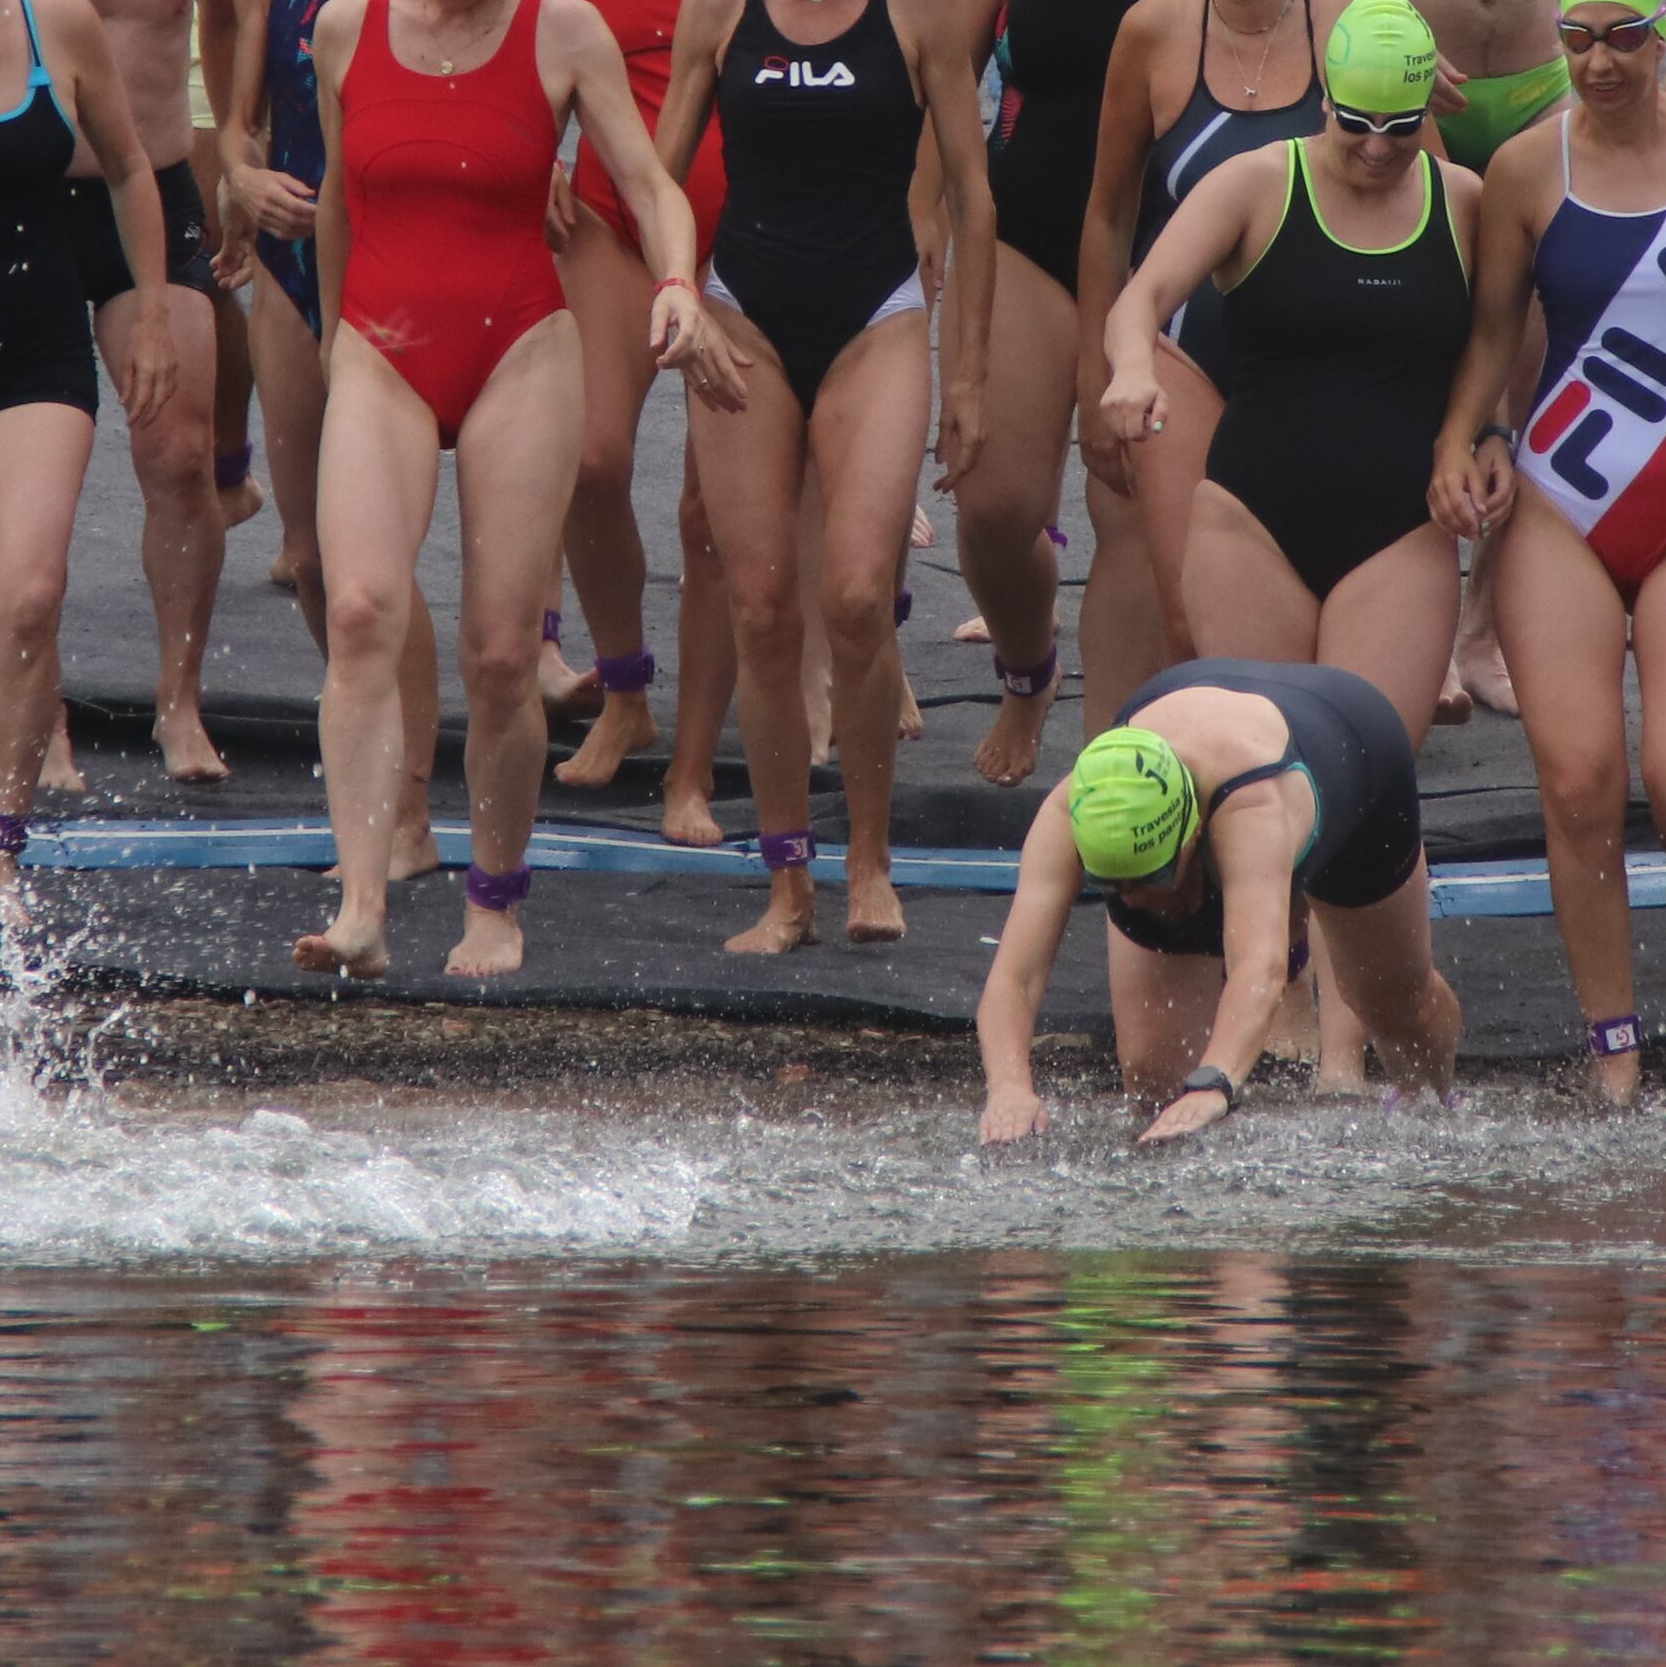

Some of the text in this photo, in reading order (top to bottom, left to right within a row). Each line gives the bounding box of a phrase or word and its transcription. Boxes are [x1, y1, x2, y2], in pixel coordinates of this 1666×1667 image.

[754, 55, 856, 87] FILA
[1403, 69, 1421, 83] los
[1133, 839, 1155, 855] los
